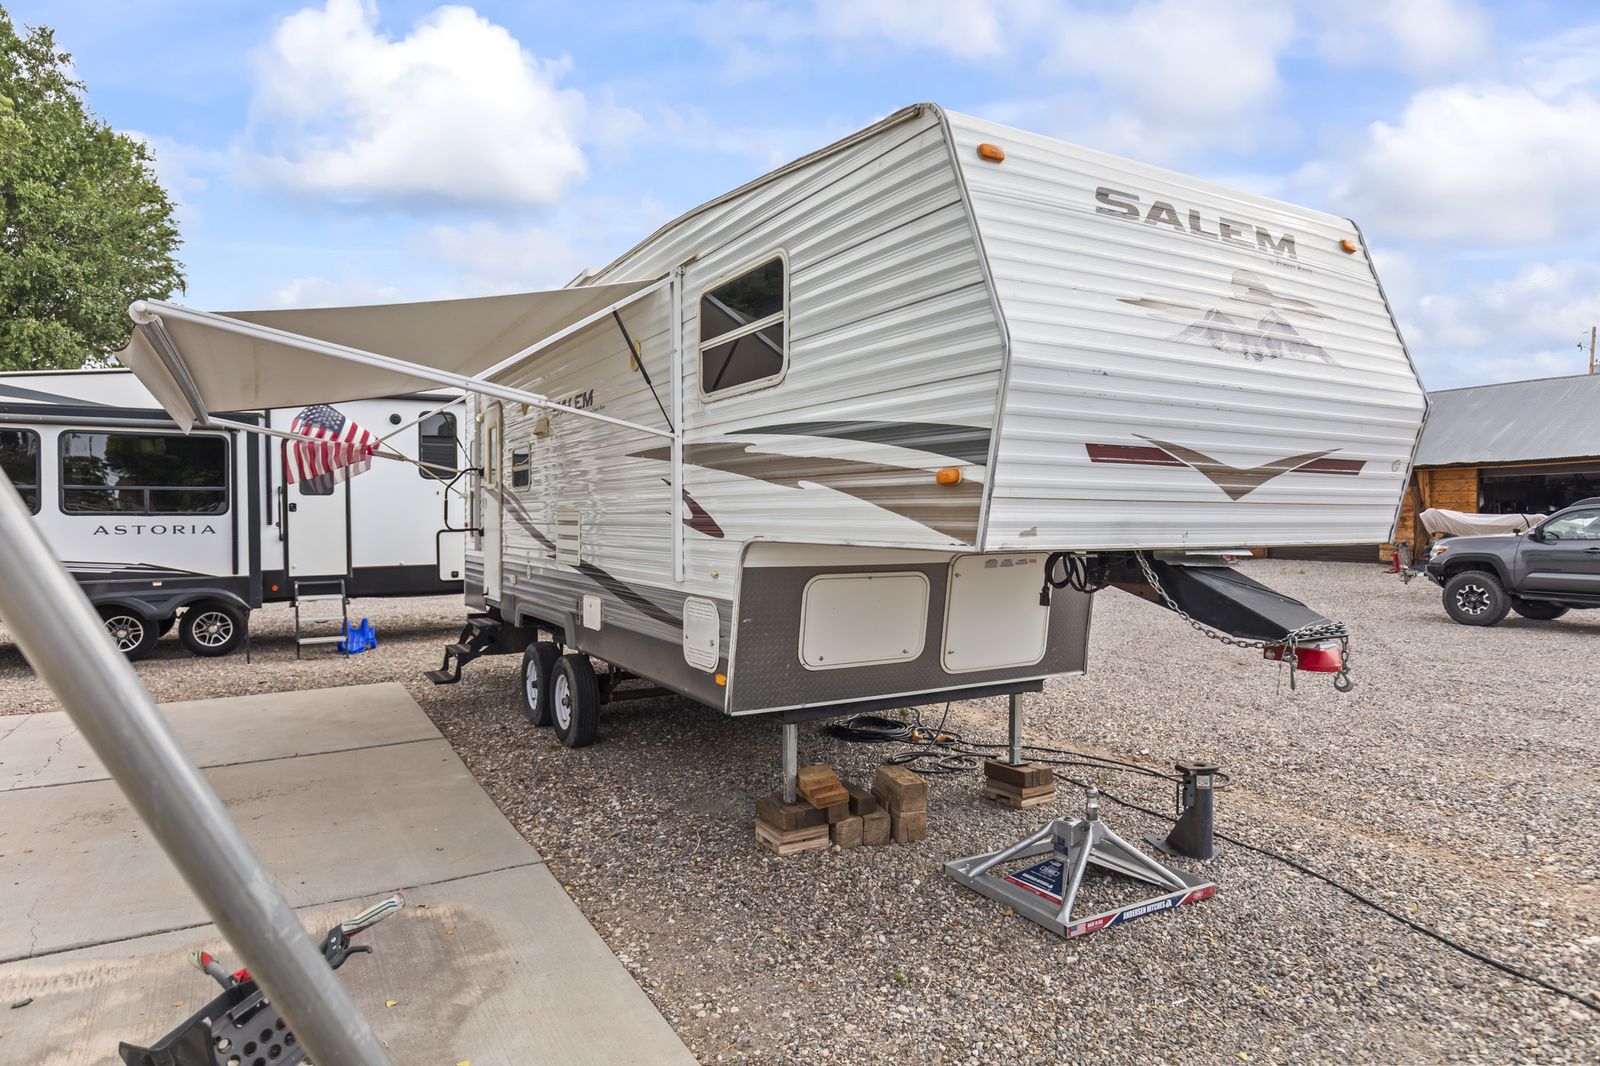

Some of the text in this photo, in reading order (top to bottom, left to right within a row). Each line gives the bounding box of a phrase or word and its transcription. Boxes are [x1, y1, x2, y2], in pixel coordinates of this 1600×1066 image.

[1095, 186, 1297, 260] SALEM
[93, 525, 216, 535] ASTORIA
[1123, 900, 1166, 920] ANDERSEN HITCHES
